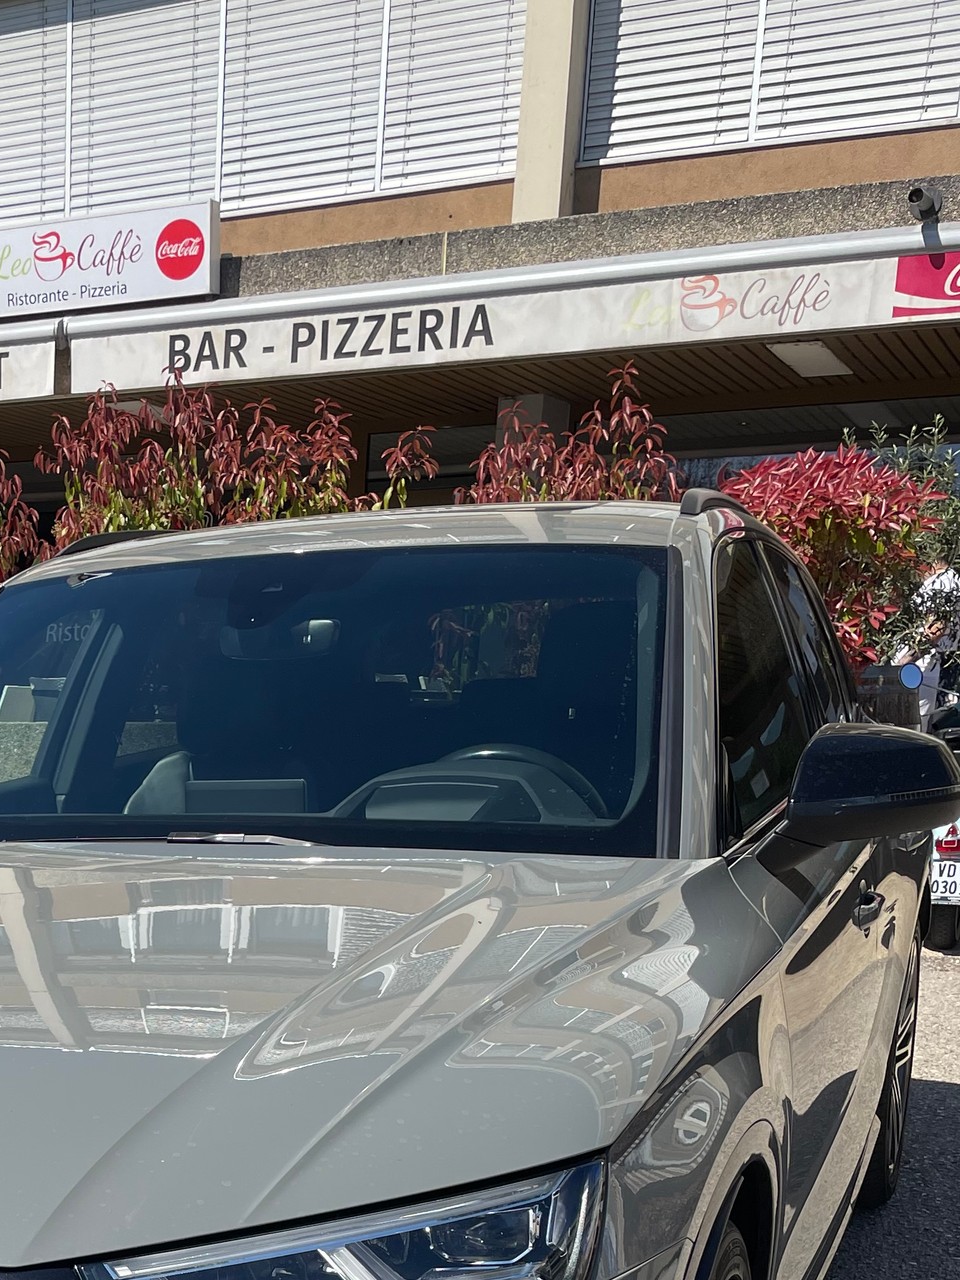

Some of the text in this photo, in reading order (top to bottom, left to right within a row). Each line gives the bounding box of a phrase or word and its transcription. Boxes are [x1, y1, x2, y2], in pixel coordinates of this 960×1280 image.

[77, 229, 143, 276] Caffè
[7, 288, 69, 307] Ristorante
[80, 281, 128, 299] Pizzeria
[740, 272, 831, 327] Caffè
[169, 329, 247, 374] BAR
[290, 304, 494, 364] PIZZERIA
[938, 863, 957, 878] VD
